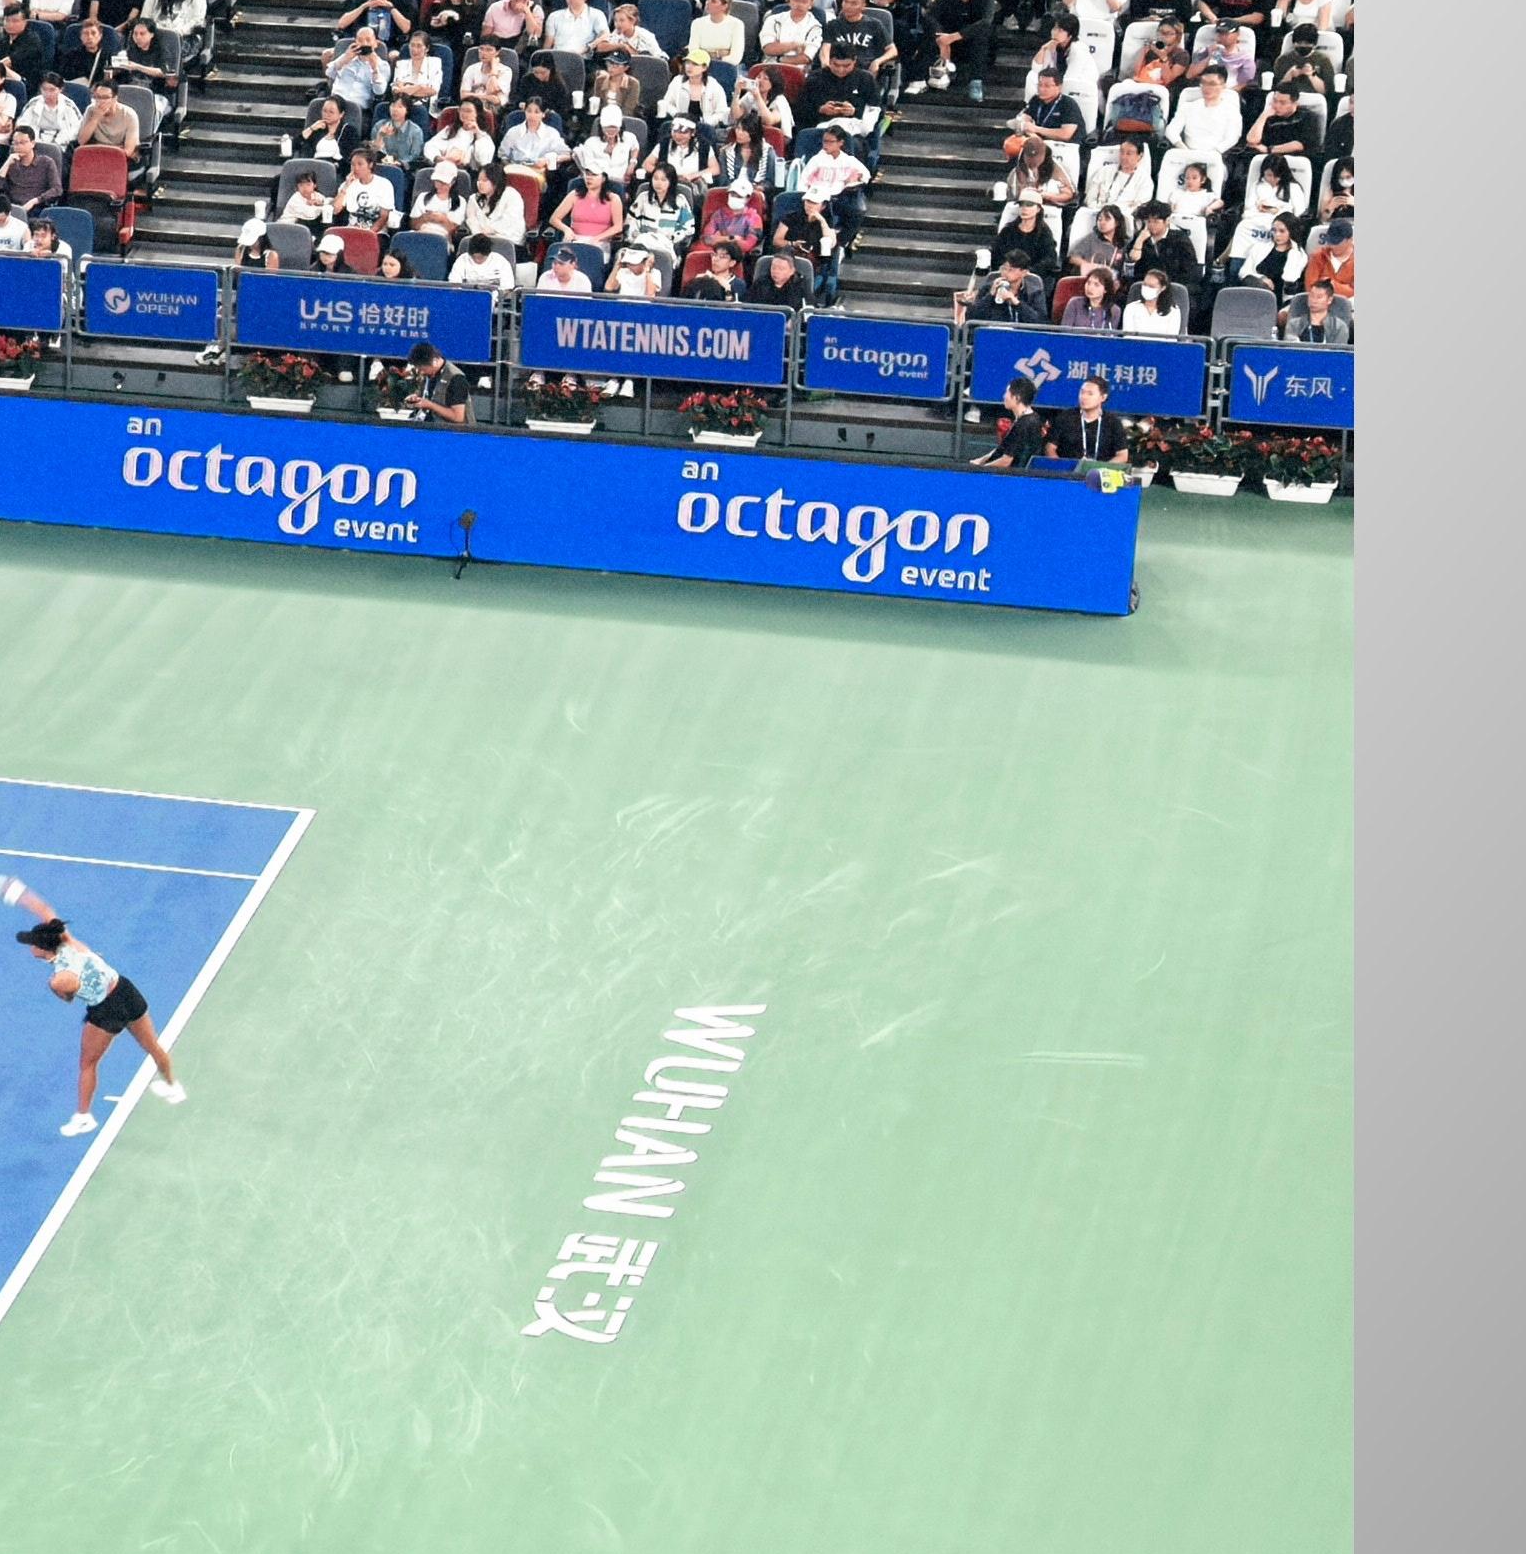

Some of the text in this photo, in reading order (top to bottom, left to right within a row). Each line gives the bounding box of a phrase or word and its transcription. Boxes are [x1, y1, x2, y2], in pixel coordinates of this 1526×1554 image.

[135, 303, 179, 315] OPEN
[136, 290, 198, 306] WUHAN
[359, 302, 430, 328] 恰好时
[555, 317, 751, 361] WTATENNIS.COM
[823, 346, 928, 376] octagon
[126, 416, 162, 436] an
[681, 459, 720, 481] an
[121, 443, 418, 535] octagon
[333, 517, 420, 543] event
[677, 488, 990, 583] octagon
[900, 565, 992, 592] event
[519, 1003, 768, 1344] WUHAN 武汉
